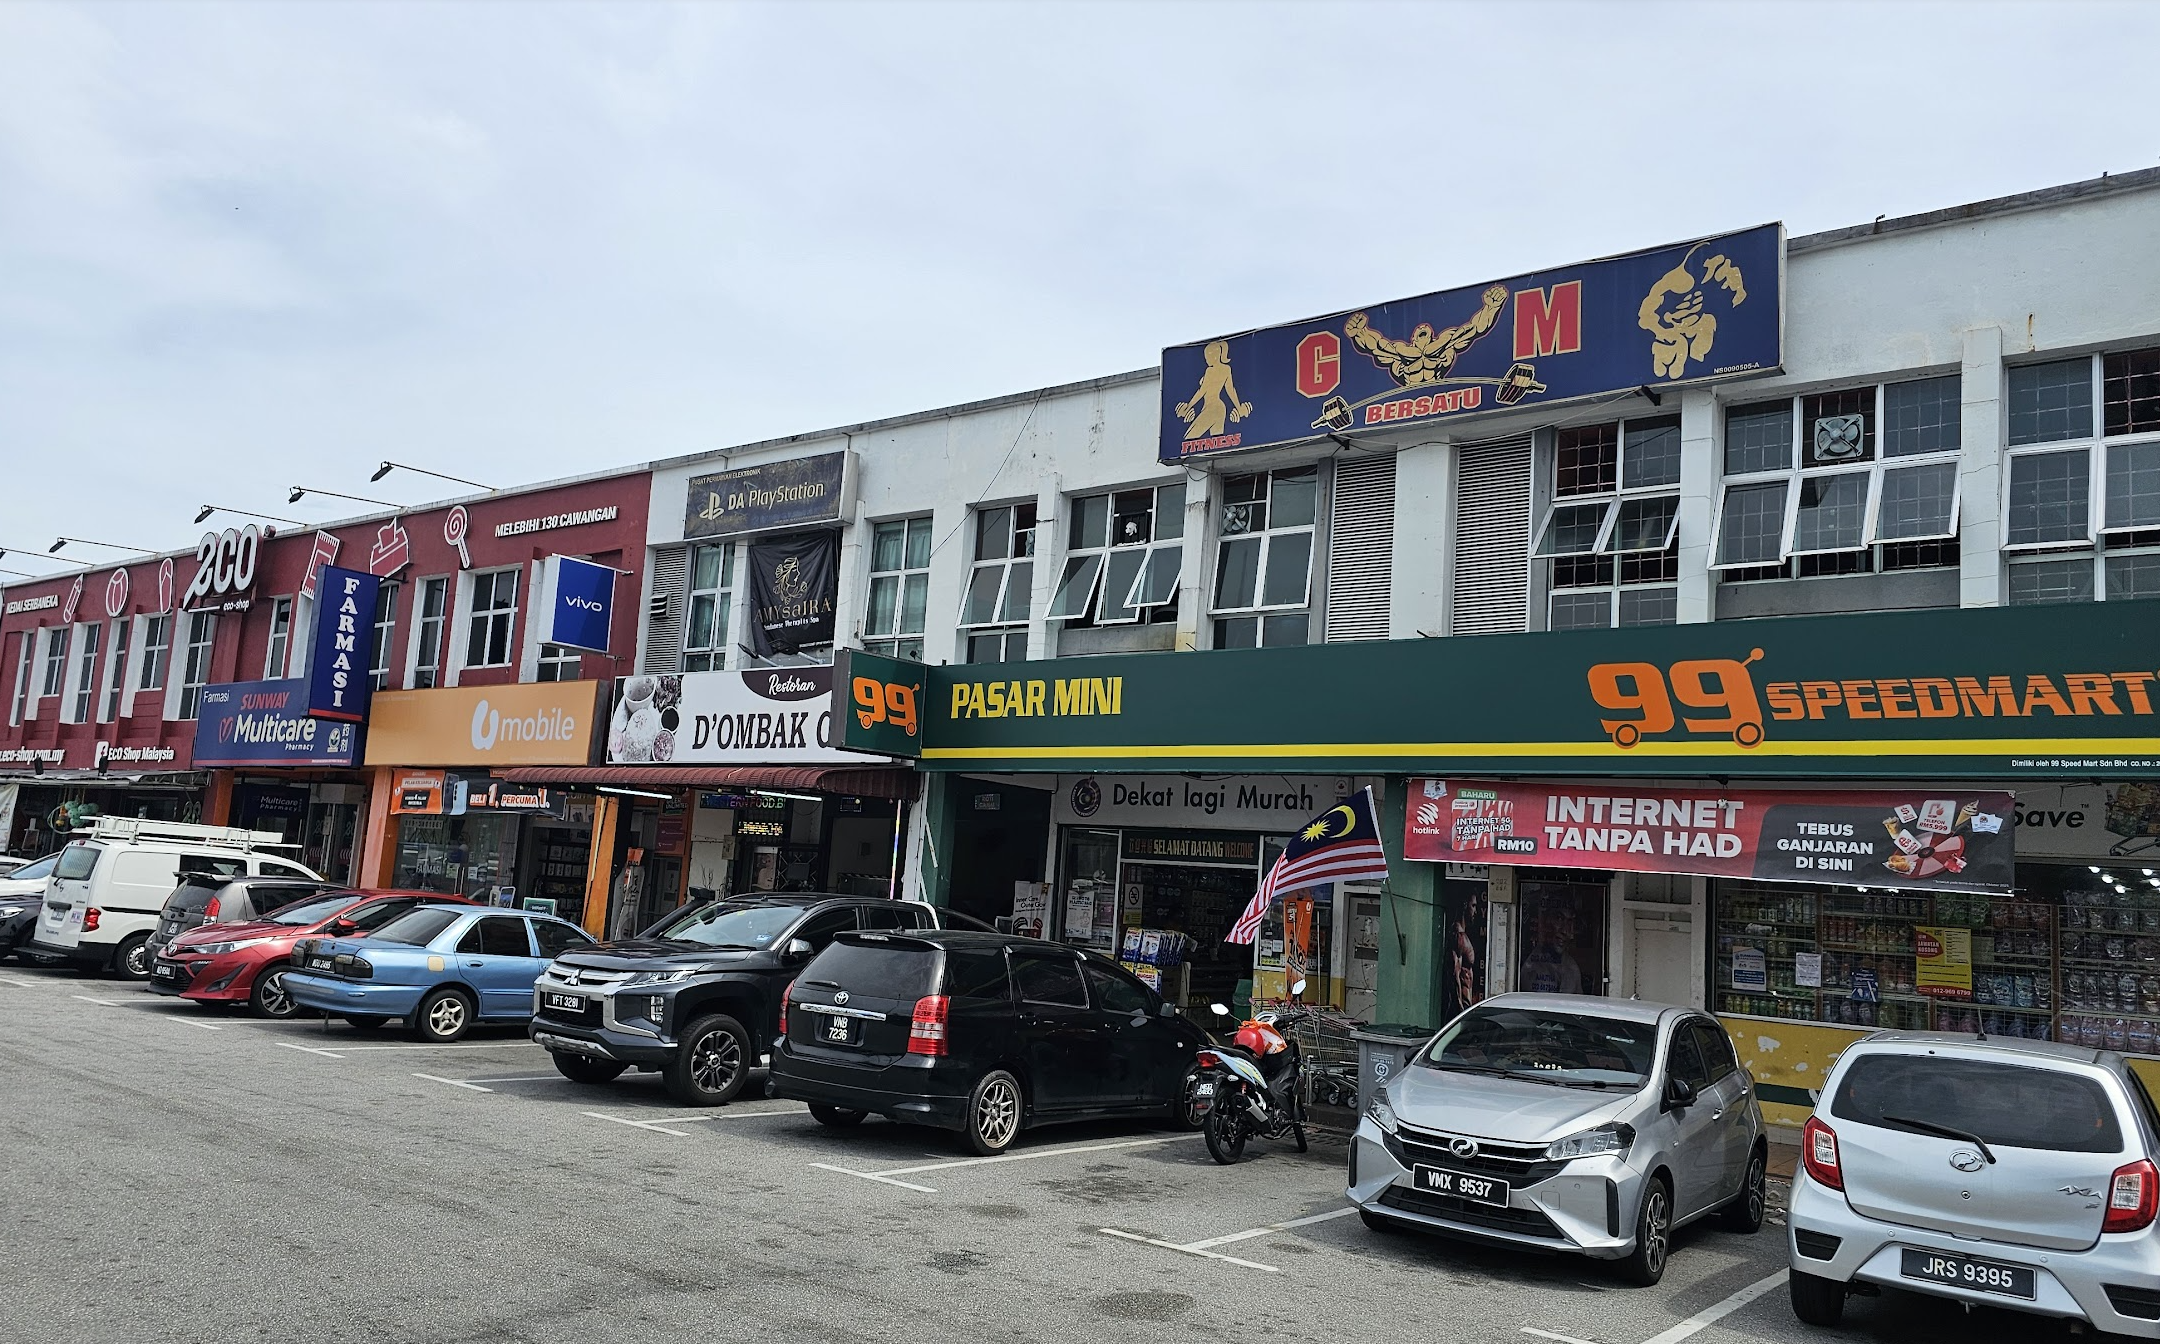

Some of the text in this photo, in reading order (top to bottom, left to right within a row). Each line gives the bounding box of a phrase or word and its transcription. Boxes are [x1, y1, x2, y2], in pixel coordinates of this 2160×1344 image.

[1296, 280, 1581, 398] G M
[1365, 387, 1481, 424] BERSATU
[1181, 433, 1241, 453] FITNESS
[728, 482, 824, 510] DA PlayStation
[495, 506, 617, 538] MELEBIHI 130 CAWANGAN
[6, 595, 58, 614] KEDAI SERBANEKA
[223, 598, 250, 611] eco-shop
[565, 595, 602, 612] vivo
[333, 576, 361, 708] FARMASI
[768, 674, 816, 694] Restoran
[203, 690, 230, 703] Farmasi
[241, 692, 290, 710] SUNWAY
[951, 676, 1122, 719] PASAR MINI
[1587, 656, 2157, 749] 99 SPEEDMART
[852, 676, 919, 738] 99
[234, 713, 316, 743] Multicare
[501, 708, 574, 742] mobile
[692, 711, 809, 749] D'OMBAK
[108, 746, 174, 763] ECO Shop Malaysia
[285, 743, 314, 751] Pharmacy
[2012, 759, 2034, 767] Dimiliki
[2060, 760, 2082, 769] Speed
[470, 794, 487, 805] BELI
[501, 795, 538, 808] PERCUMA
[1113, 783, 1174, 806] Dekat
[1184, 784, 1226, 814] lagi
[1236, 785, 1314, 810] Murah
[1461, 791, 1495, 799] BAHARU
[1456, 817, 1499, 826] INTERNET
[1546, 795, 1744, 829] INTERNET
[1413, 826, 1440, 835] hotlink
[1457, 824, 1511, 835] TANPA HAD
[1796, 822, 1854, 837] TEBUS
[1154, 839, 1254, 859] SELAMAT DATANG WELCOME
[1497, 839, 1534, 852] RM10
[1544, 826, 1743, 858] TANPA HAD
[1776, 838, 1873, 855] GANJARAN
[1795, 856, 1853, 872] DI SINI
[834, 1016, 848, 1028] VNB
[829, 1028, 848, 1040] 7236
[1428, 1171, 1492, 1197] VMX 9537
[1922, 1257, 2012, 1288] JRS 9395
